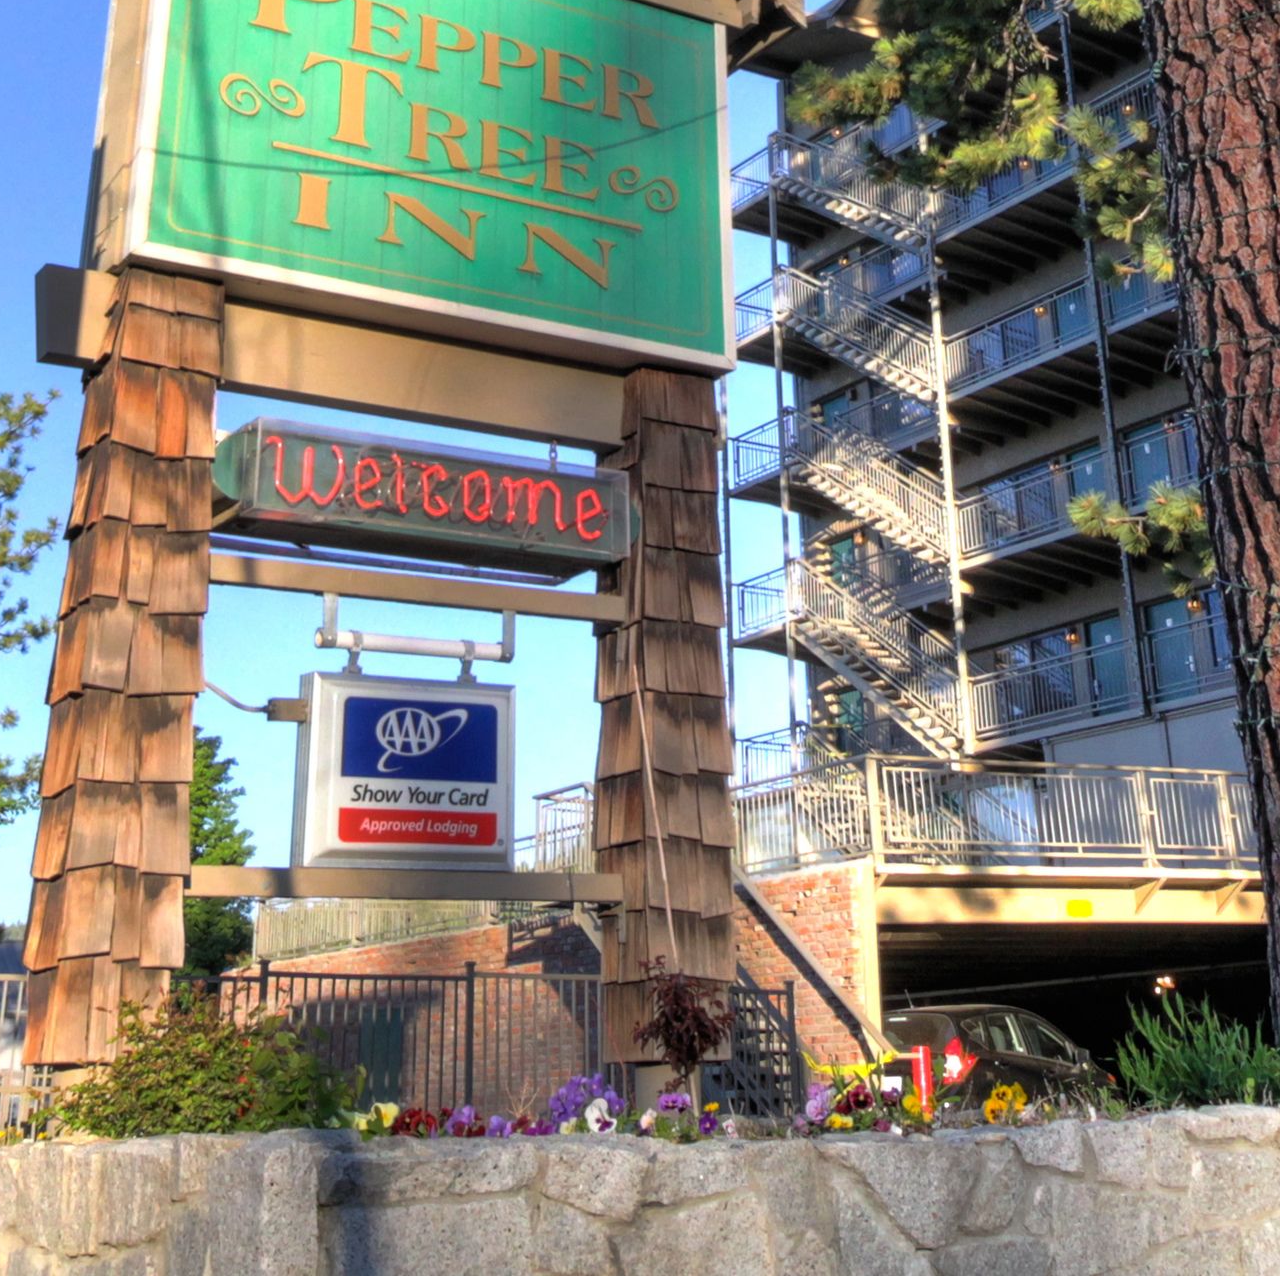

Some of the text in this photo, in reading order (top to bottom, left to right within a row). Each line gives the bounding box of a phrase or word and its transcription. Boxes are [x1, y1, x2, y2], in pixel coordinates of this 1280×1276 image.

[302, 51, 602, 202] TREE
[292, 172, 618, 290] INN
[265, 435, 605, 542] Welcome
[381, 709, 436, 755] AAA
[350, 783, 490, 807] Show Your Card
[359, 816, 479, 837] Approved Lodging
